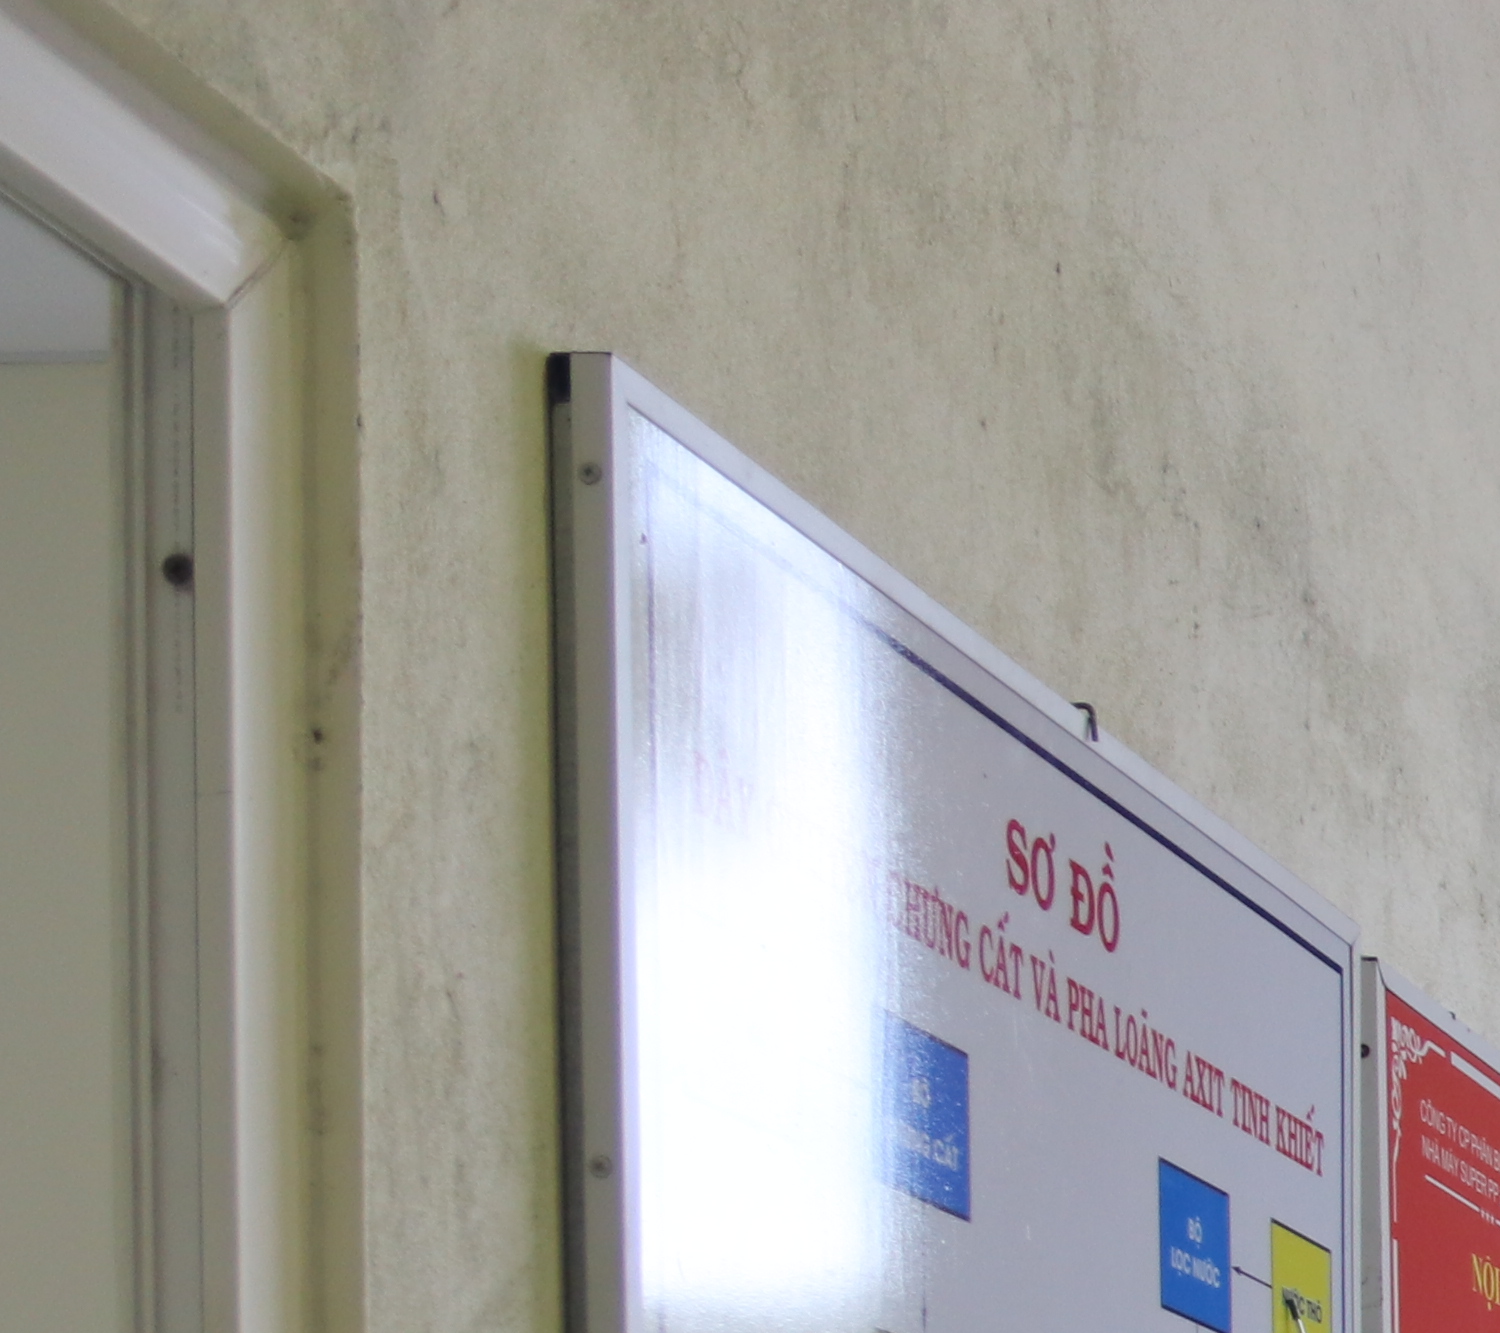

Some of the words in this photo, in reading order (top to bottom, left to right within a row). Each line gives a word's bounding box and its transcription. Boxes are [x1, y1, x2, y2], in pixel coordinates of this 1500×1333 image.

[1006, 820, 1055, 910] SƠ
[1069, 844, 1120, 952] ĐỒ
[978, 913, 1024, 999] CẤT
[1030, 951, 1061, 1023] VÀ
[1067, 978, 1109, 1050] PHA
[1114, 1007, 1177, 1089] LOÃNG
[1183, 1052, 1225, 1116] AXIT
[1230, 1078, 1270, 1145] TINH
[1275, 1106, 1324, 1175] KHIẾT
[1420, 1099, 1446, 1135] CÔNG
[1445, 1116, 1458, 1142] TY
[1460, 1160, 1488, 1195] SUPER
[1187, 1216, 1203, 1249] BỘ
[1170, 1247, 1192, 1276] LỌC
[1191, 1257, 1220, 1288] NƯỚC
[1472, 1254, 1500, 1310] NỘI
